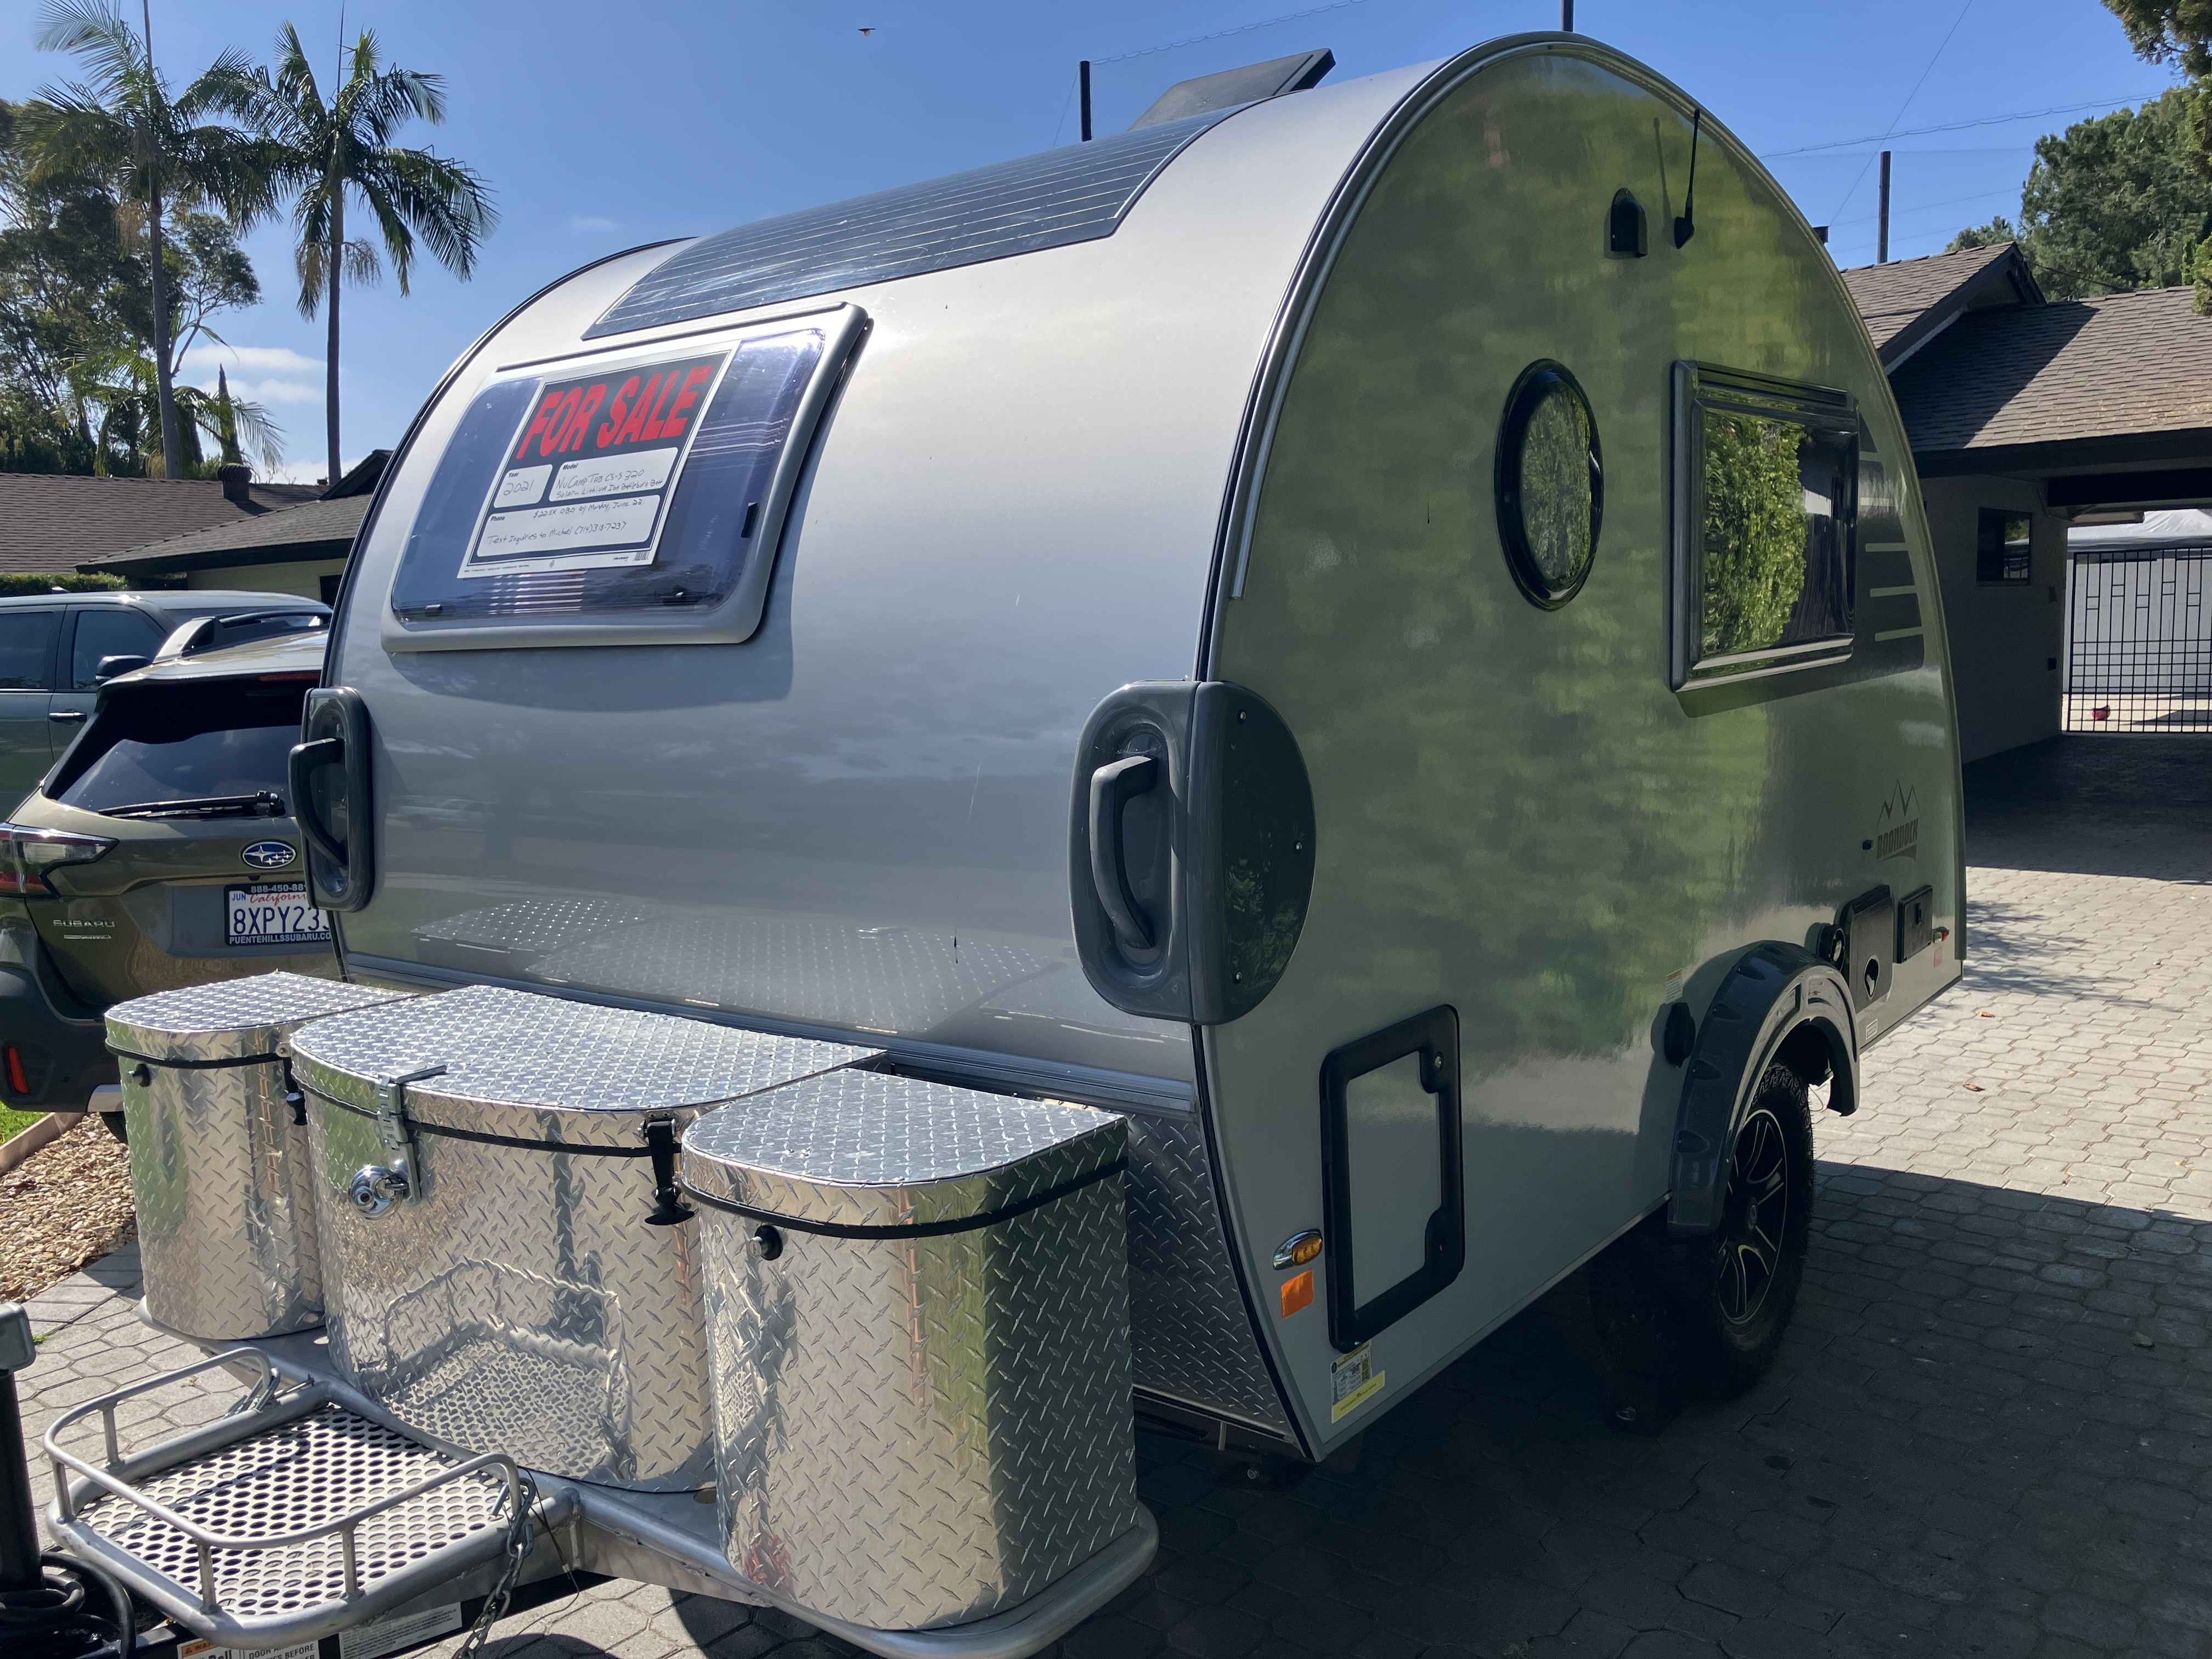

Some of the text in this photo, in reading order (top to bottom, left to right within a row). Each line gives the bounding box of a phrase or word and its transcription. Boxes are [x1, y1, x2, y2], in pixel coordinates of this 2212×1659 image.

[516, 365, 713, 459] FOR SALE
[624, 470, 645, 481] 320
[503, 479, 534, 496] 2021
[582, 486, 606, 495] Lithium
[579, 505, 586, 515] by
[487, 535, 507, 545] Text
[251, 884, 307, 893] 888-450-88
[250, 893, 308, 906] Californi
[53, 919, 115, 928] SUBARU
[234, 906, 329, 934] 8XPY23
[229, 933, 331, 944] PUENTEHILLSSUBARU.CO
[285, 1643, 315, 1659] BEFORE
